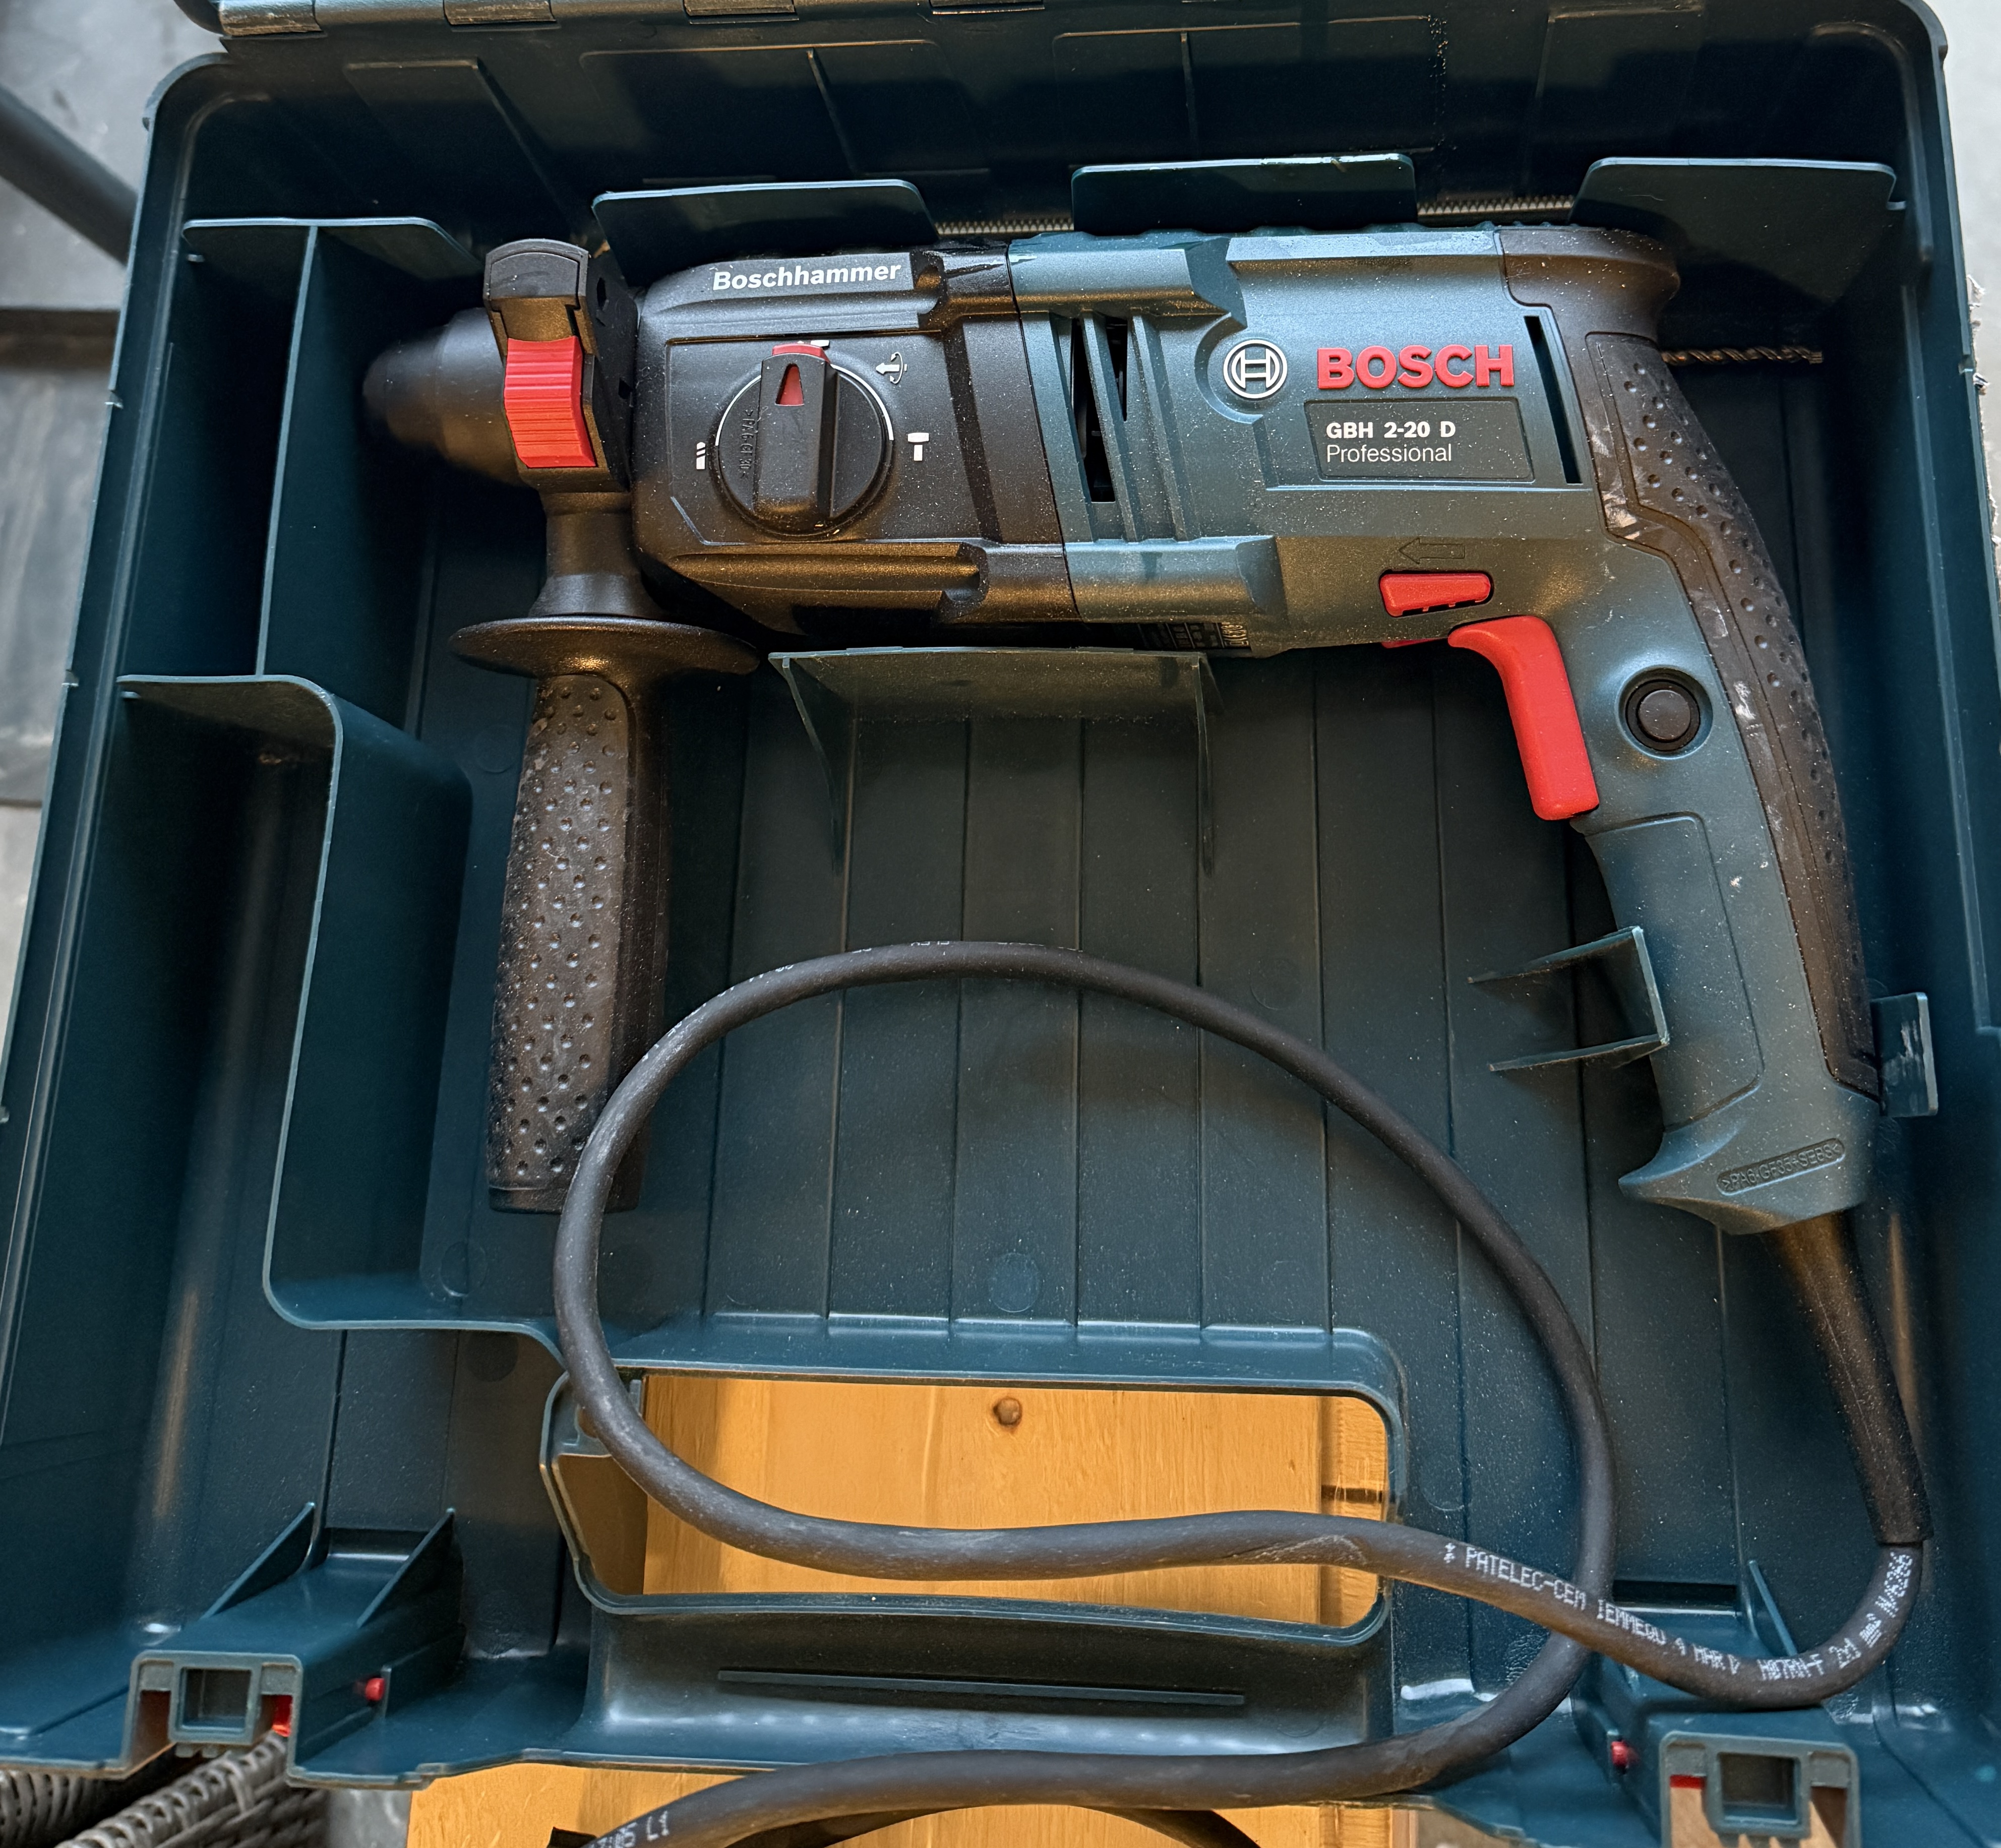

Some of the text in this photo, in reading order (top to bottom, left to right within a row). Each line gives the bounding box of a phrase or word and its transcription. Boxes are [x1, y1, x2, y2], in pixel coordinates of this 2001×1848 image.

[712, 263, 901, 291] Boschhammer
[1316, 344, 1515, 390] BOSCH
[1326, 421, 1456, 440] GBH 2-20 D
[1326, 443, 1452, 463] Professional
[1465, 1547, 1587, 1611] PATELEC-CEM
